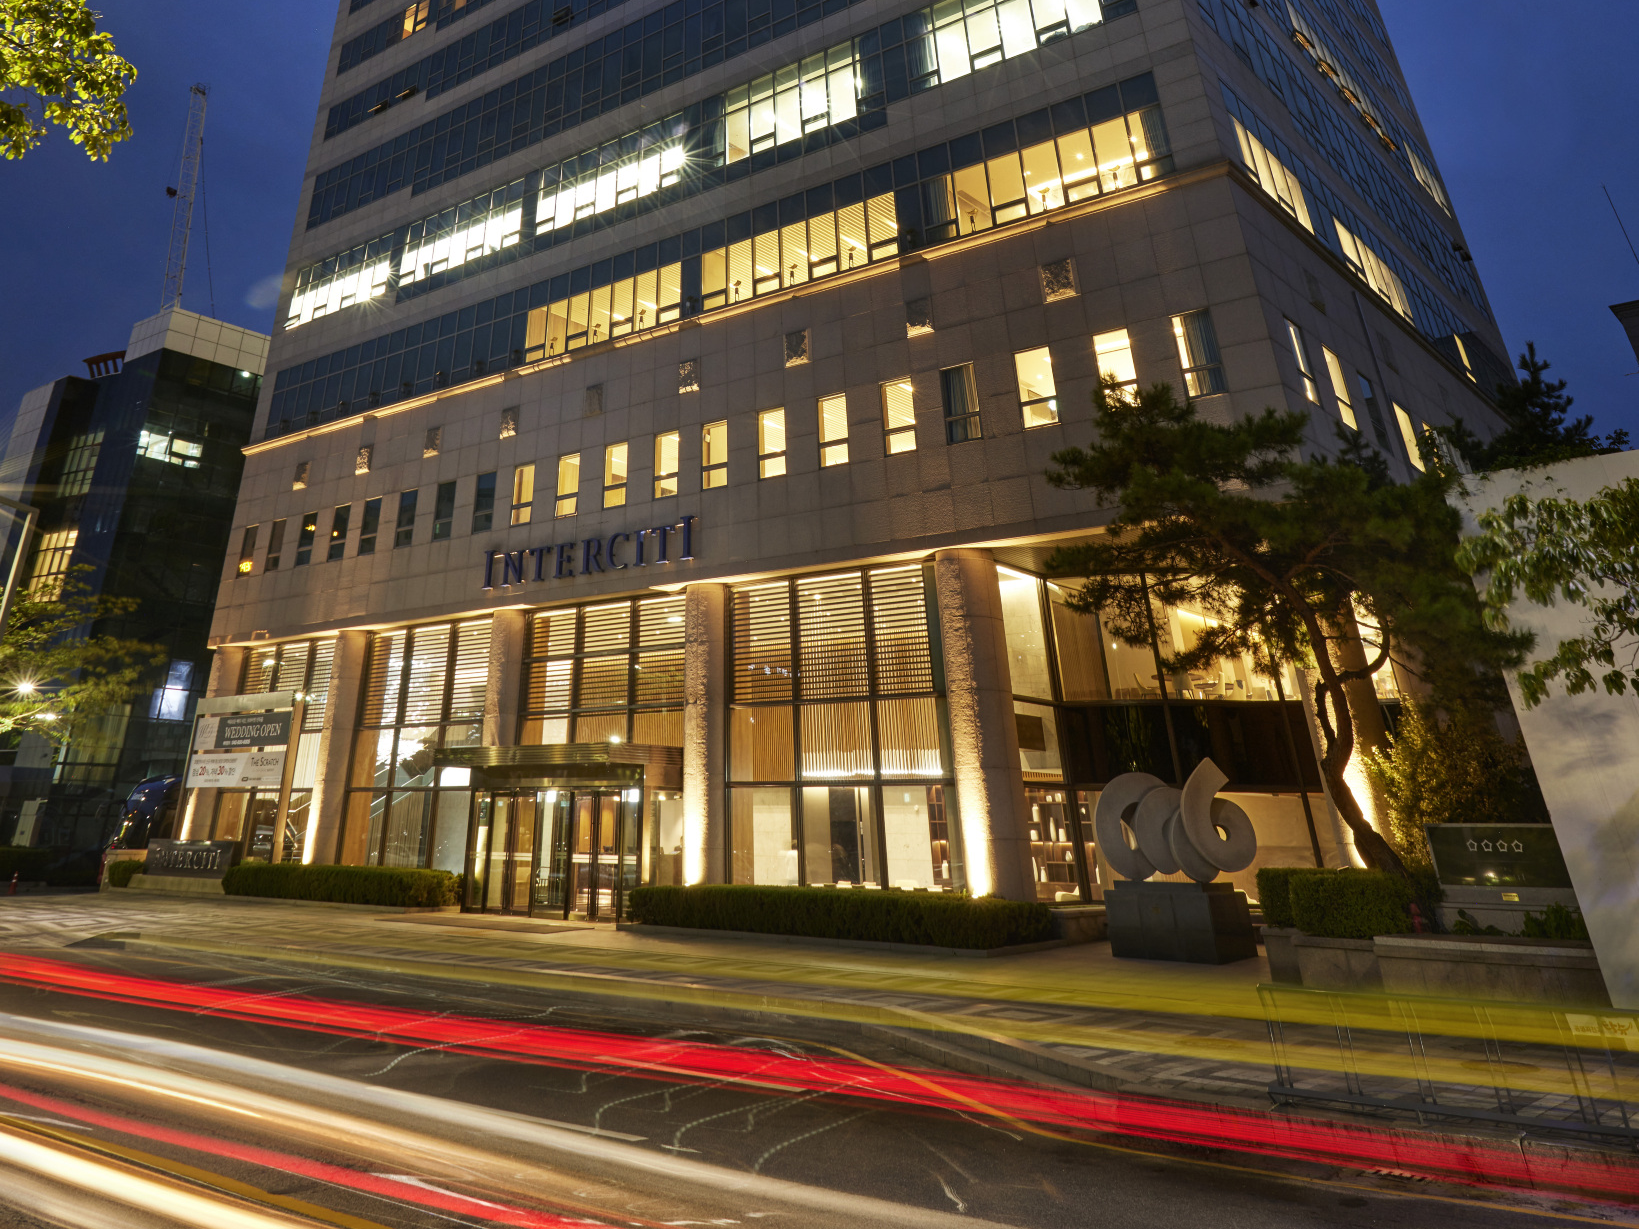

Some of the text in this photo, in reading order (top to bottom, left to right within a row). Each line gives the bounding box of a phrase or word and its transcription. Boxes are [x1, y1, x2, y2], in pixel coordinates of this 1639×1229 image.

[481, 515, 695, 591] INTERCITI
[224, 724, 260, 739] WEDDING
[260, 723, 282, 737] OPEN
[251, 756, 280, 767] THE SCRATCH
